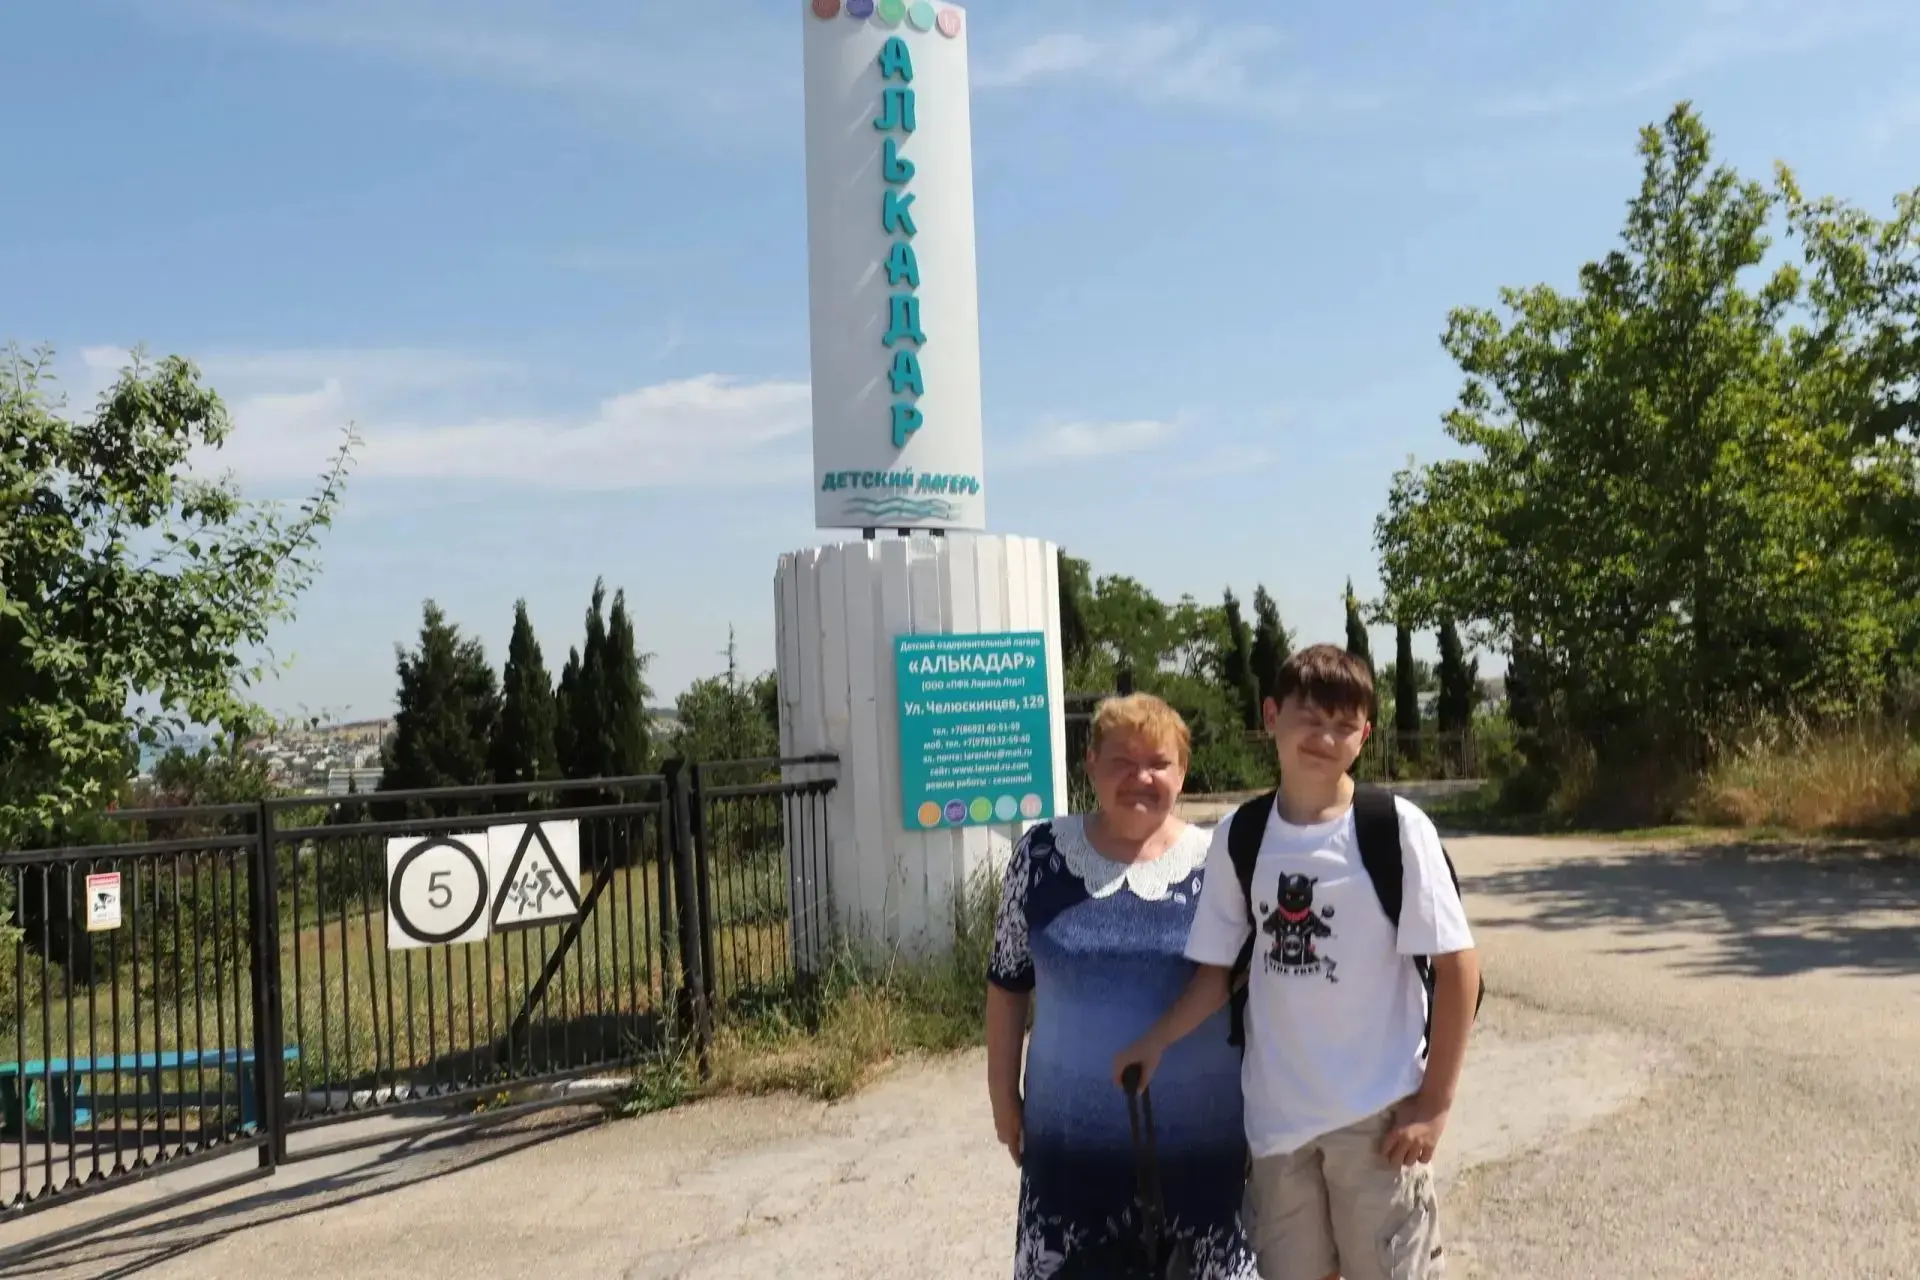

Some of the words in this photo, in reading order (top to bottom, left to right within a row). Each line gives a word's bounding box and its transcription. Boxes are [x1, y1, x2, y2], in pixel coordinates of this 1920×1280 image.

[873, 36, 928, 449] АЛЬКАДАР
[822, 466, 914, 491] ДЕТСКИЙ
[900, 639, 935, 651] Детский
[908, 652, 1036, 675] «АЛЬКАДАР»
[904, 701, 925, 716] Ул.
[926, 697, 1020, 715] Челюскинцев,
[1022, 694, 1045, 710] 129
[427, 870, 453, 909] 5
